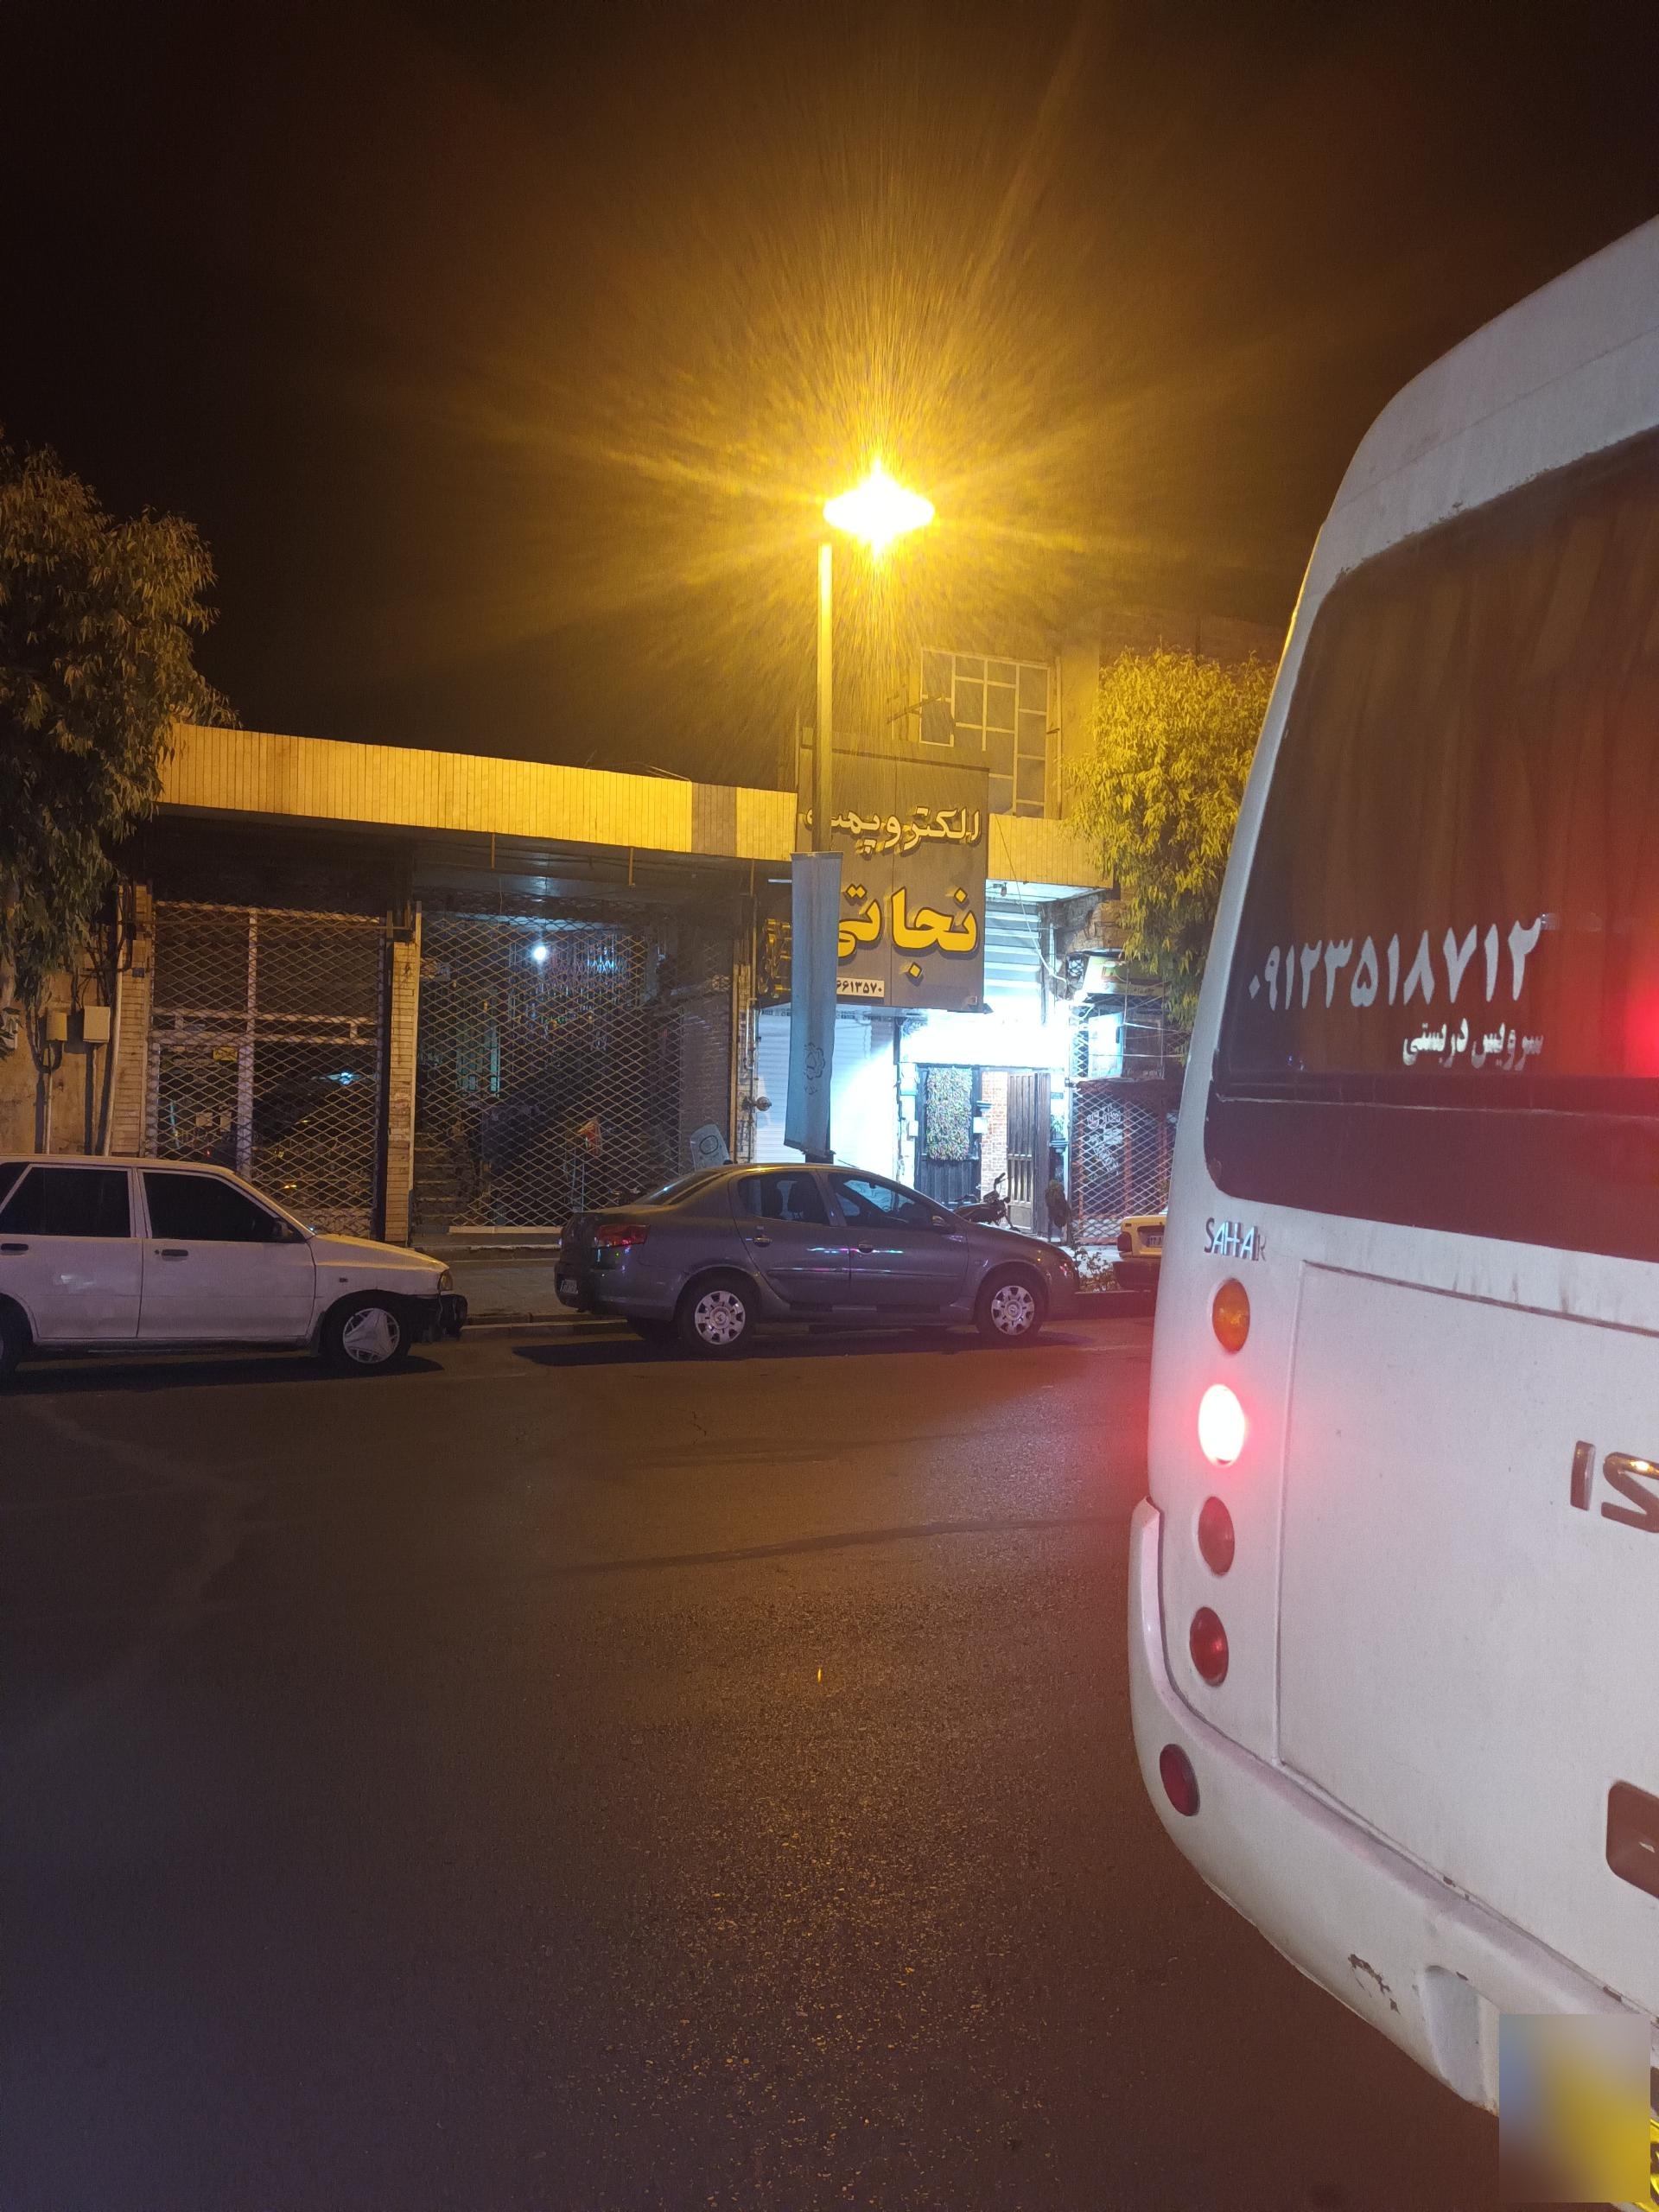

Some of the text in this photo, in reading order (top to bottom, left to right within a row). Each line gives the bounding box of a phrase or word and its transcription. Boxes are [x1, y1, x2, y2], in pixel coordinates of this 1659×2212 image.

[1248, 917, 1541, 1012] ۰۹۱۲۳۵۱۸۷۱۲
[1402, 1017, 1543, 1071] سرویس دربستی
[1204, 1217, 1267, 1262] SAHAR
